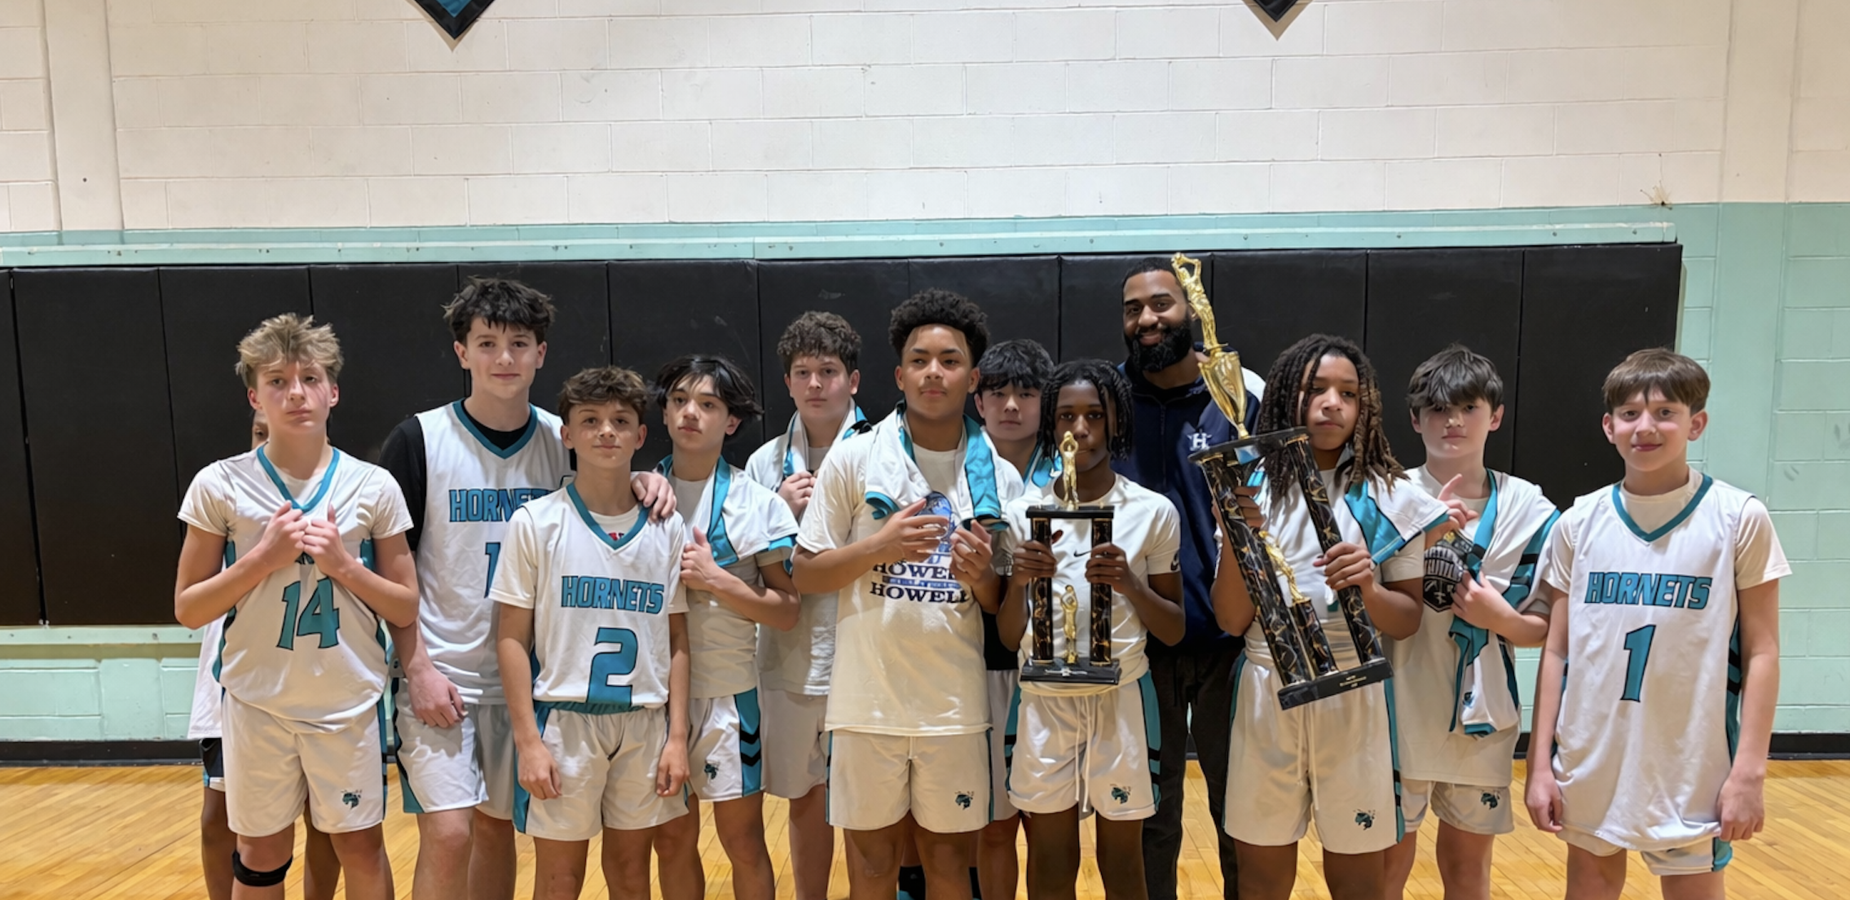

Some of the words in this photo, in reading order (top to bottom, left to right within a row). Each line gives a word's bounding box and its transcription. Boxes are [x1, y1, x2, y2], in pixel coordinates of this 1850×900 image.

[1189, 432, 1211, 451] H
[449, 488, 556, 523] HORNE
[872, 558, 956, 580] HOWE
[561, 575, 665, 615] HORNETS
[1584, 571, 1713, 610] HORNETS
[276, 576, 340, 651] 14
[586, 627, 639, 707] 2
[1620, 624, 1657, 703] 1
